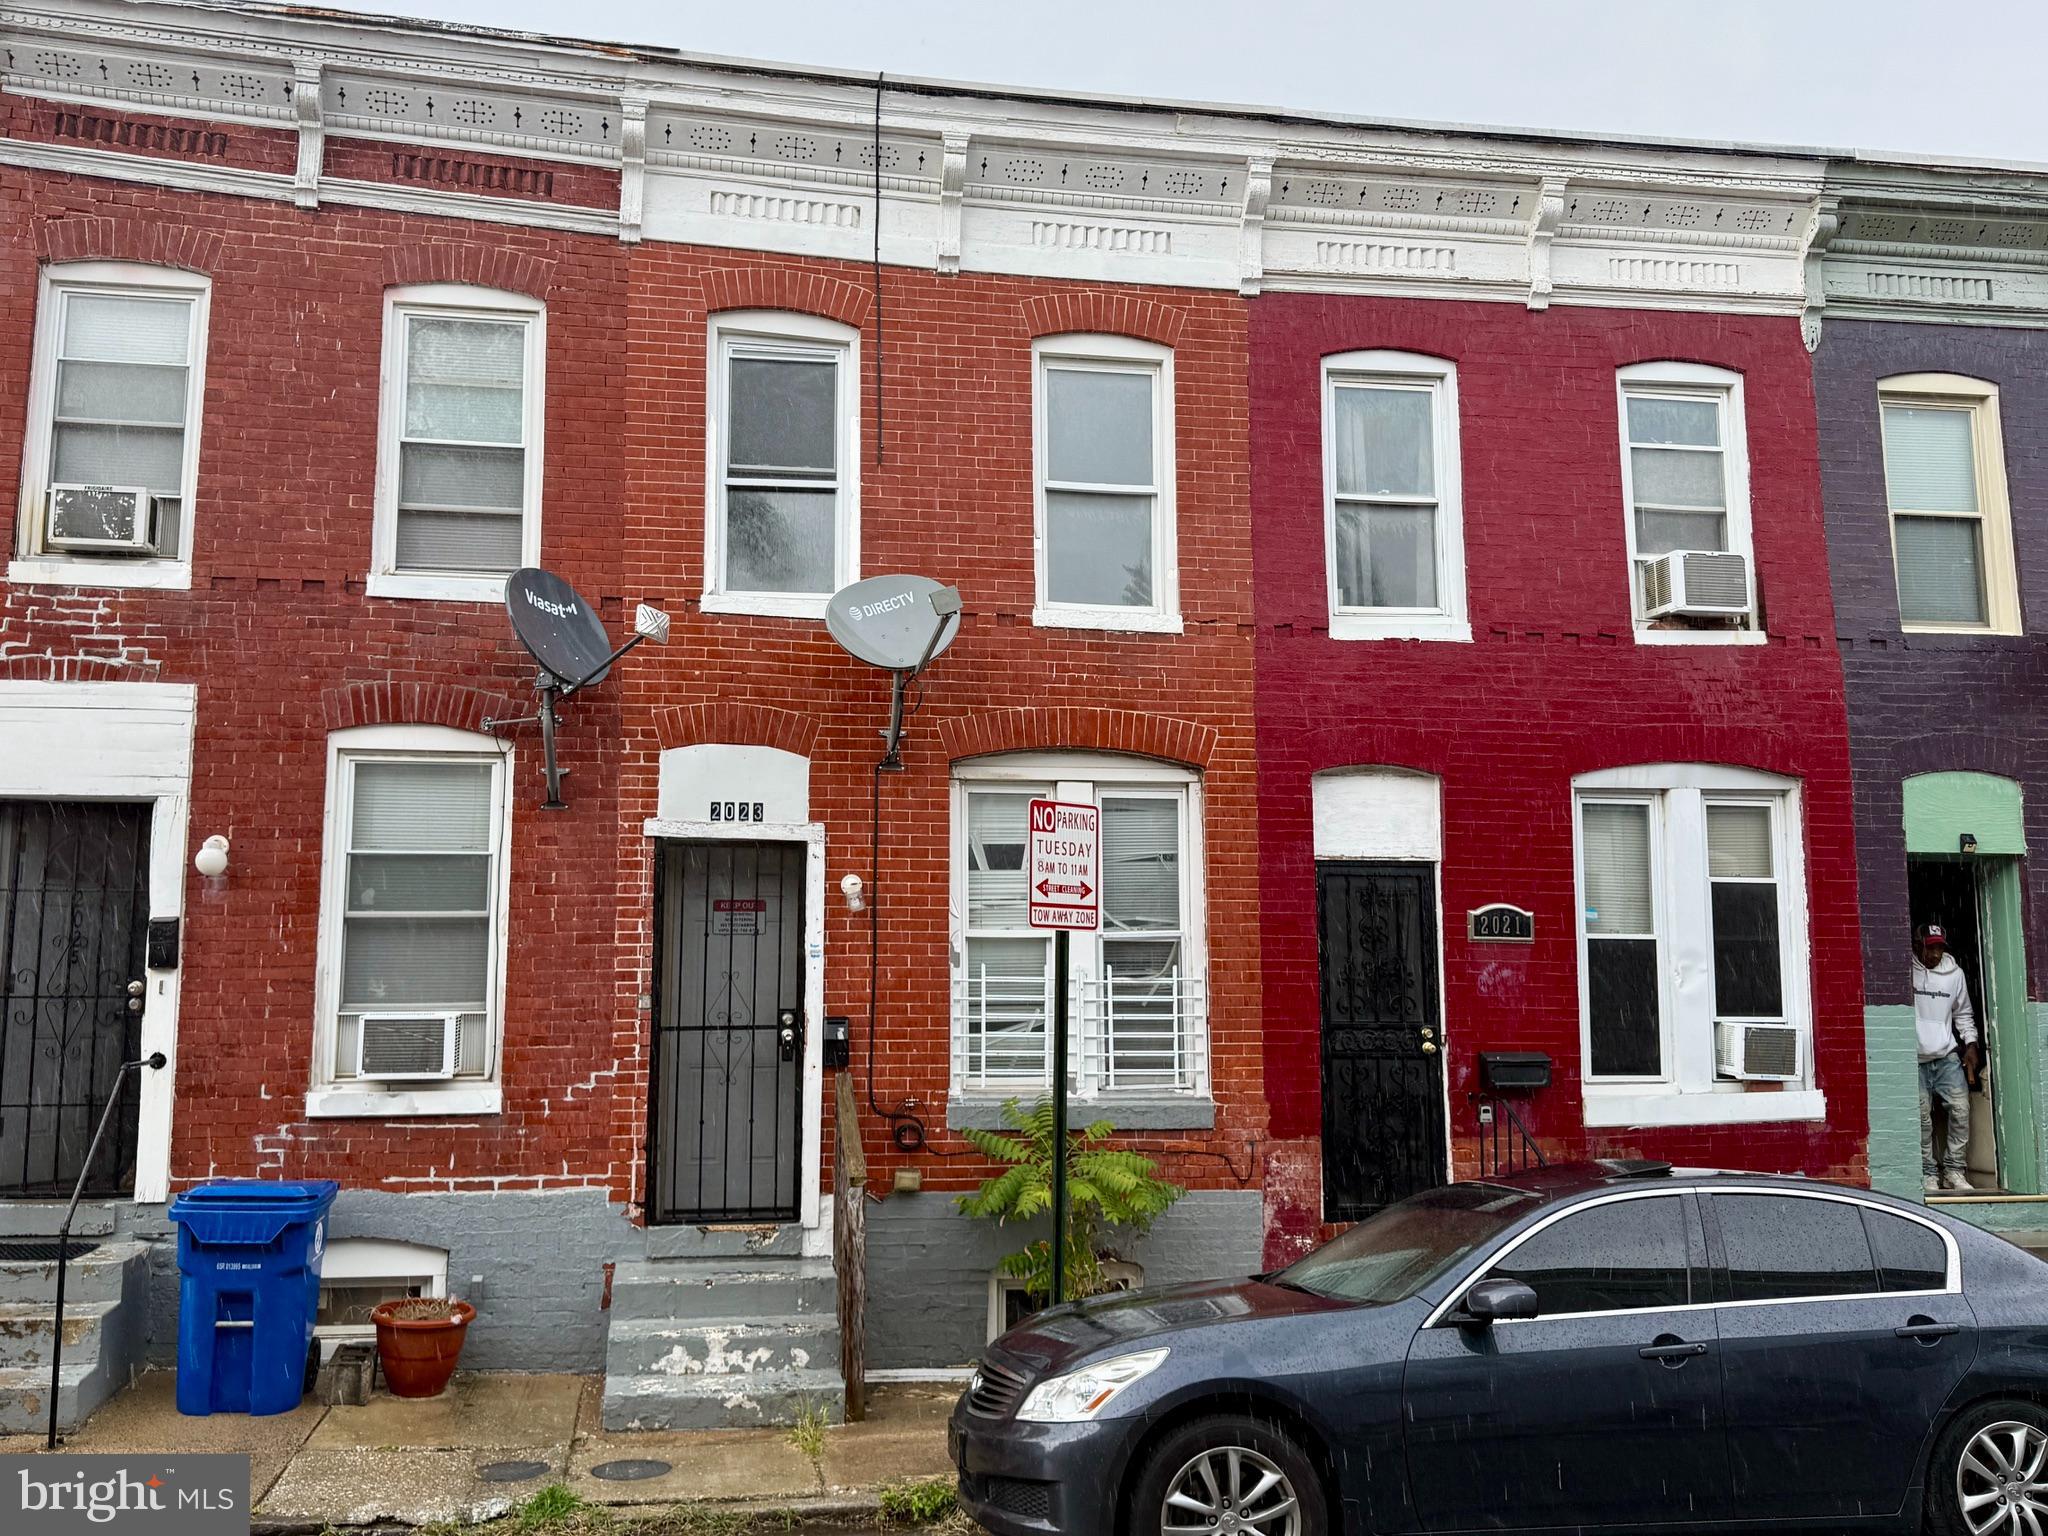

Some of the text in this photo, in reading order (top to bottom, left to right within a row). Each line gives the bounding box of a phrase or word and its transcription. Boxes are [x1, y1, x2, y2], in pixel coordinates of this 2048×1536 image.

[525, 588, 566, 619] Viasat
[863, 591, 914, 617] DIRECTV
[711, 803, 762, 821] 2023
[1033, 805, 1095, 832] NO PARKING
[1037, 839, 1092, 858] TUESDAY
[1058, 863, 1068, 875] TO
[1042, 884, 1086, 895] STREET CLEANING
[1033, 909, 1095, 925] TOW AWAY ZONE
[1480, 915, 1521, 935] 2021
